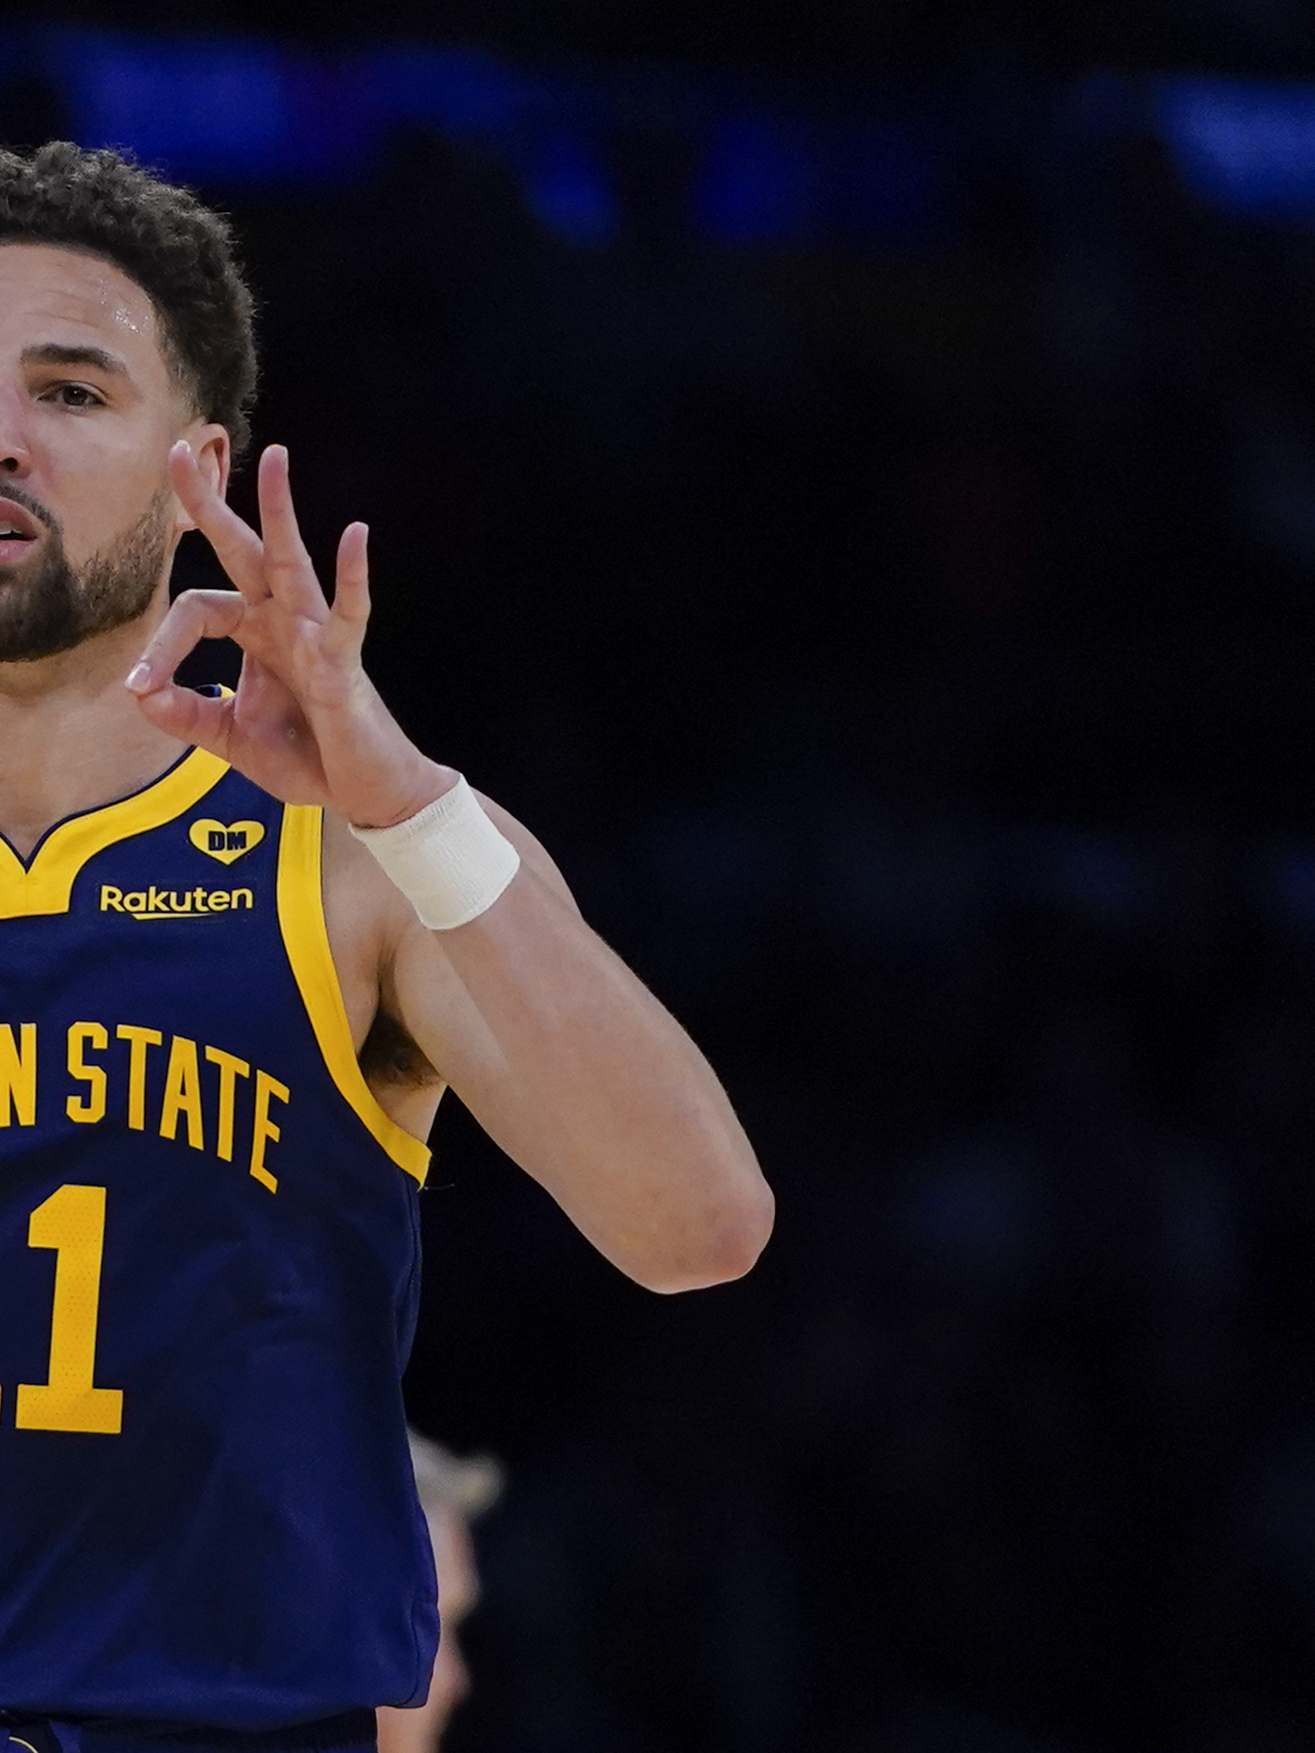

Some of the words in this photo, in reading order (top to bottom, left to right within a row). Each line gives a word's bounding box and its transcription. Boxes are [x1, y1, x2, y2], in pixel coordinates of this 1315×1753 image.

[208, 831, 247, 851] DM
[100, 885, 254, 914] Rakuten
[65, 1020, 291, 1195] STATE
